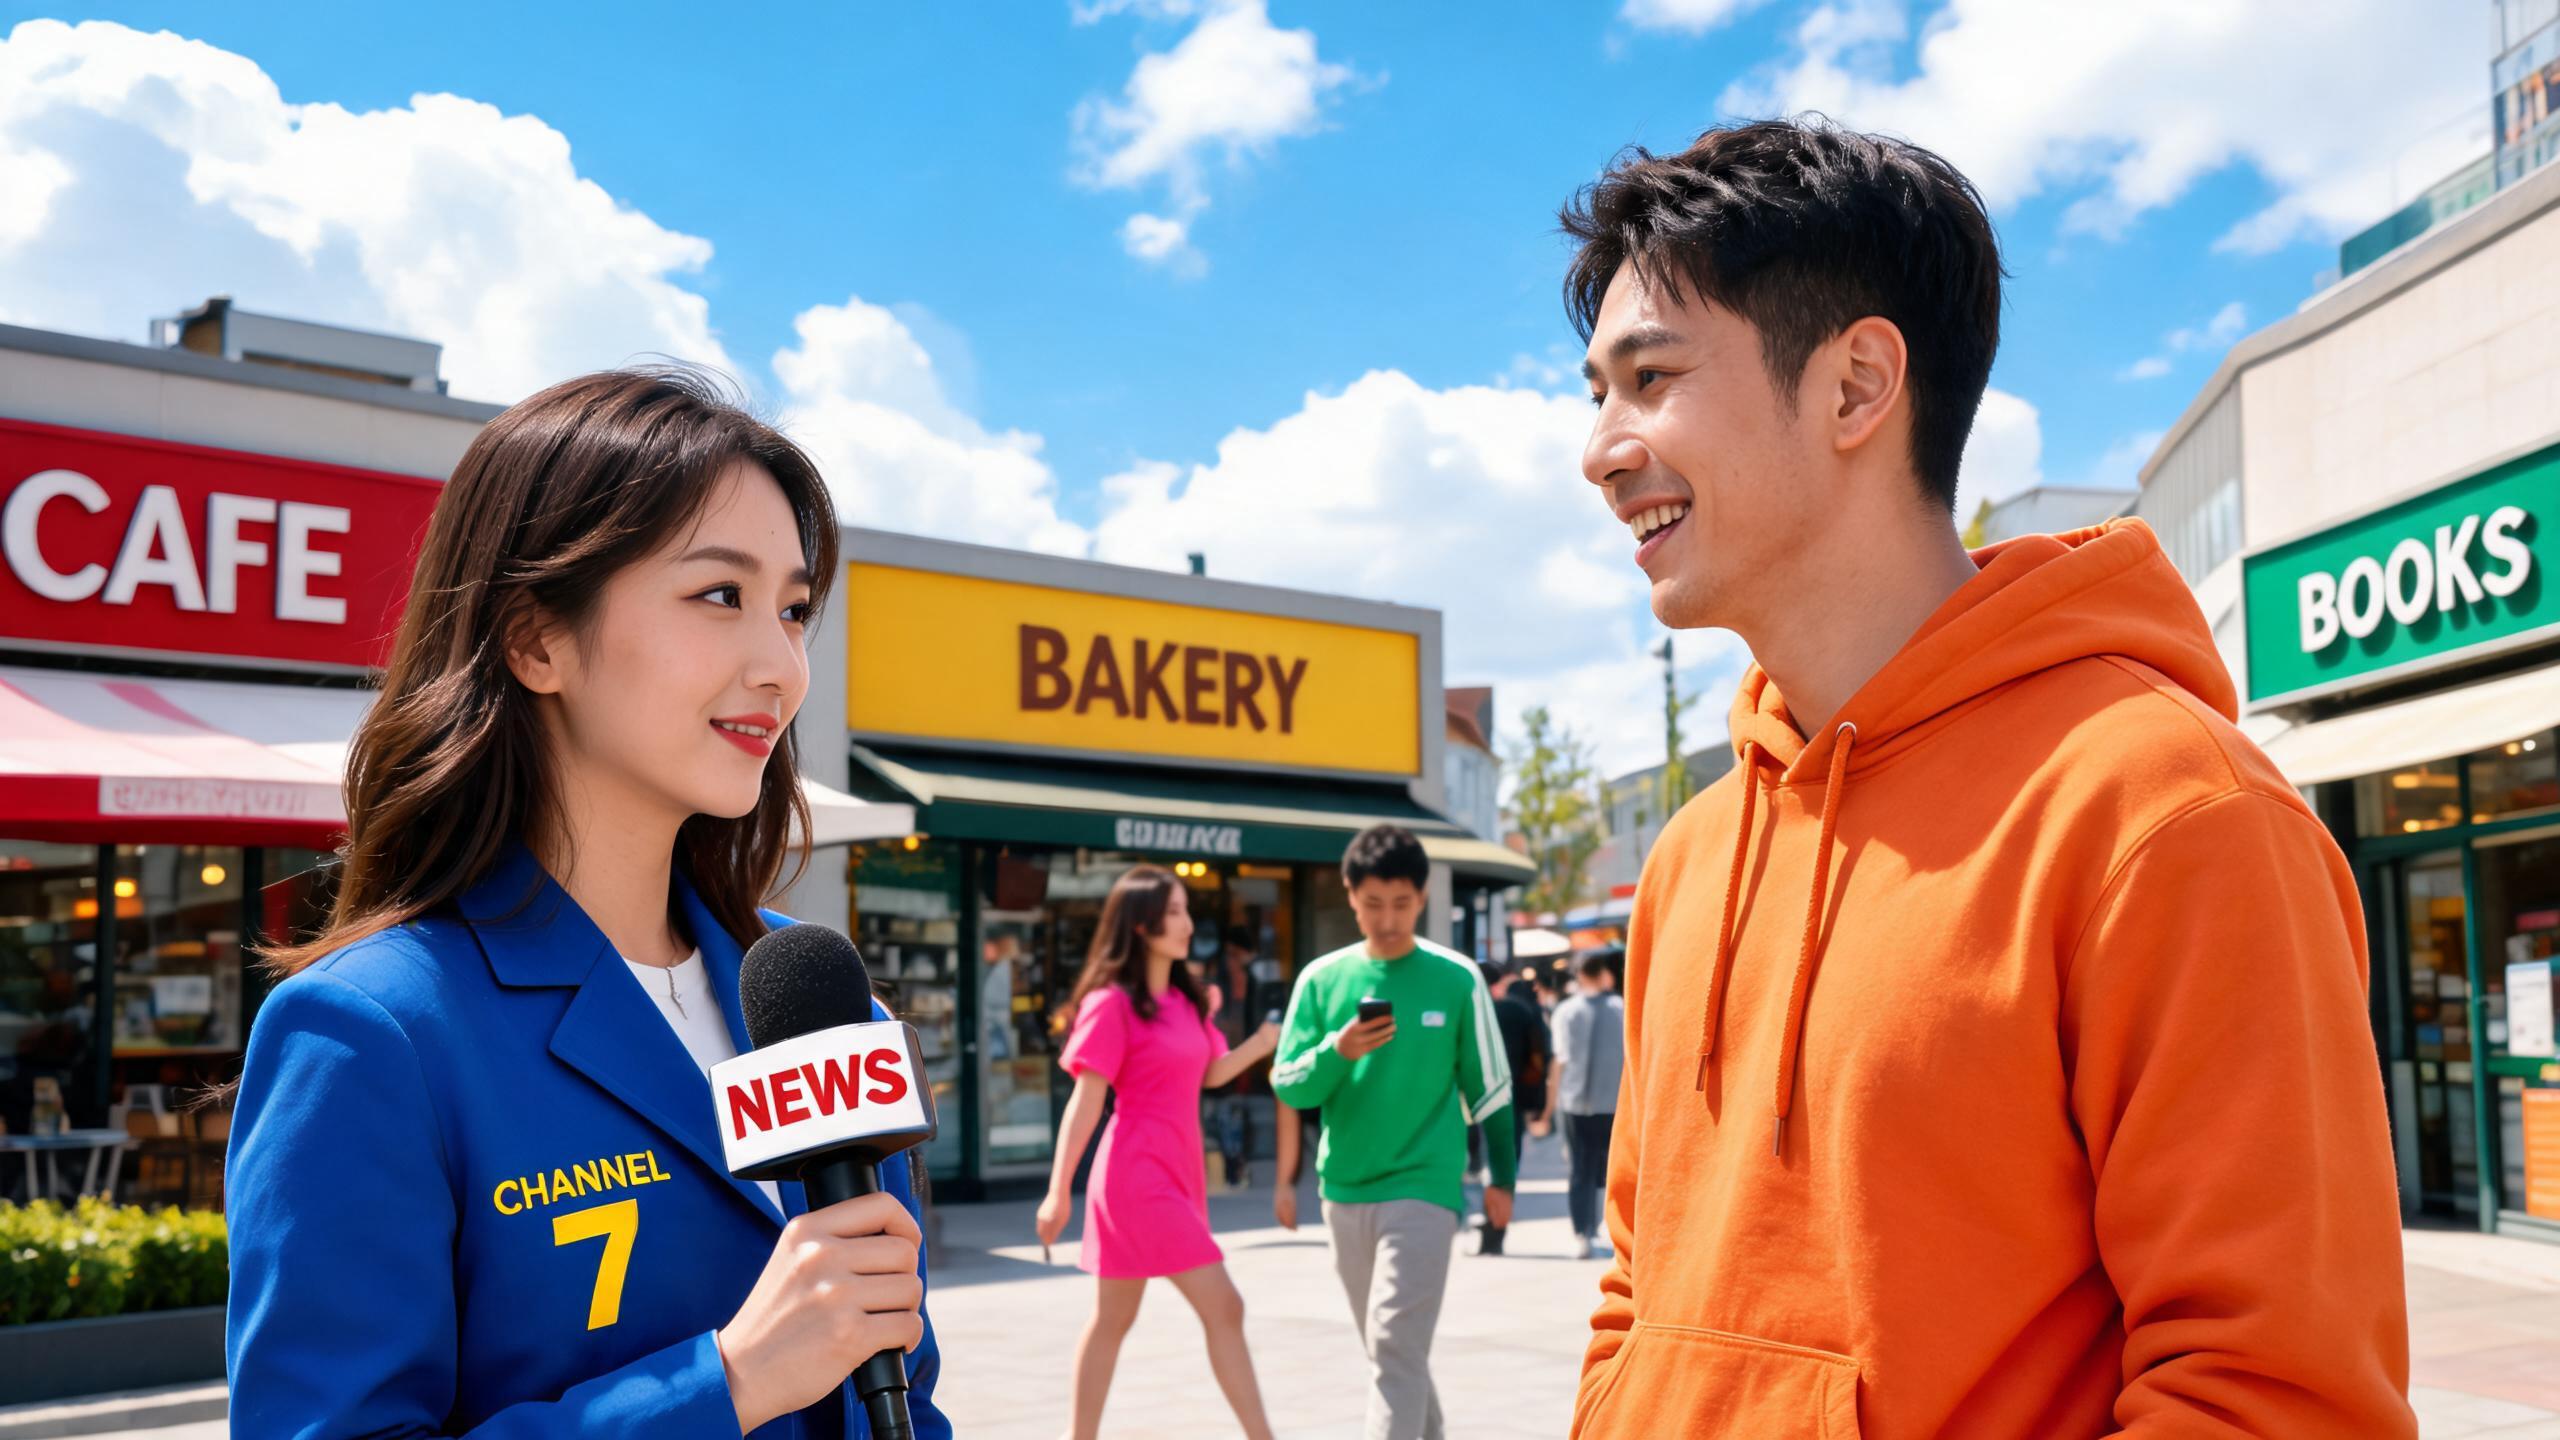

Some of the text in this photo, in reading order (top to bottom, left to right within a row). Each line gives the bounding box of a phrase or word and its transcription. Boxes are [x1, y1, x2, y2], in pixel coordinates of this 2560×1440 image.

[3, 470, 351, 624] CAFE
[2298, 505, 2531, 653] BOOKS
[1018, 623, 1308, 734] BAKERY
[727, 1049, 907, 1140] NEWS
[493, 1151, 671, 1216] CHANNEL
[553, 1198, 638, 1331] 7
